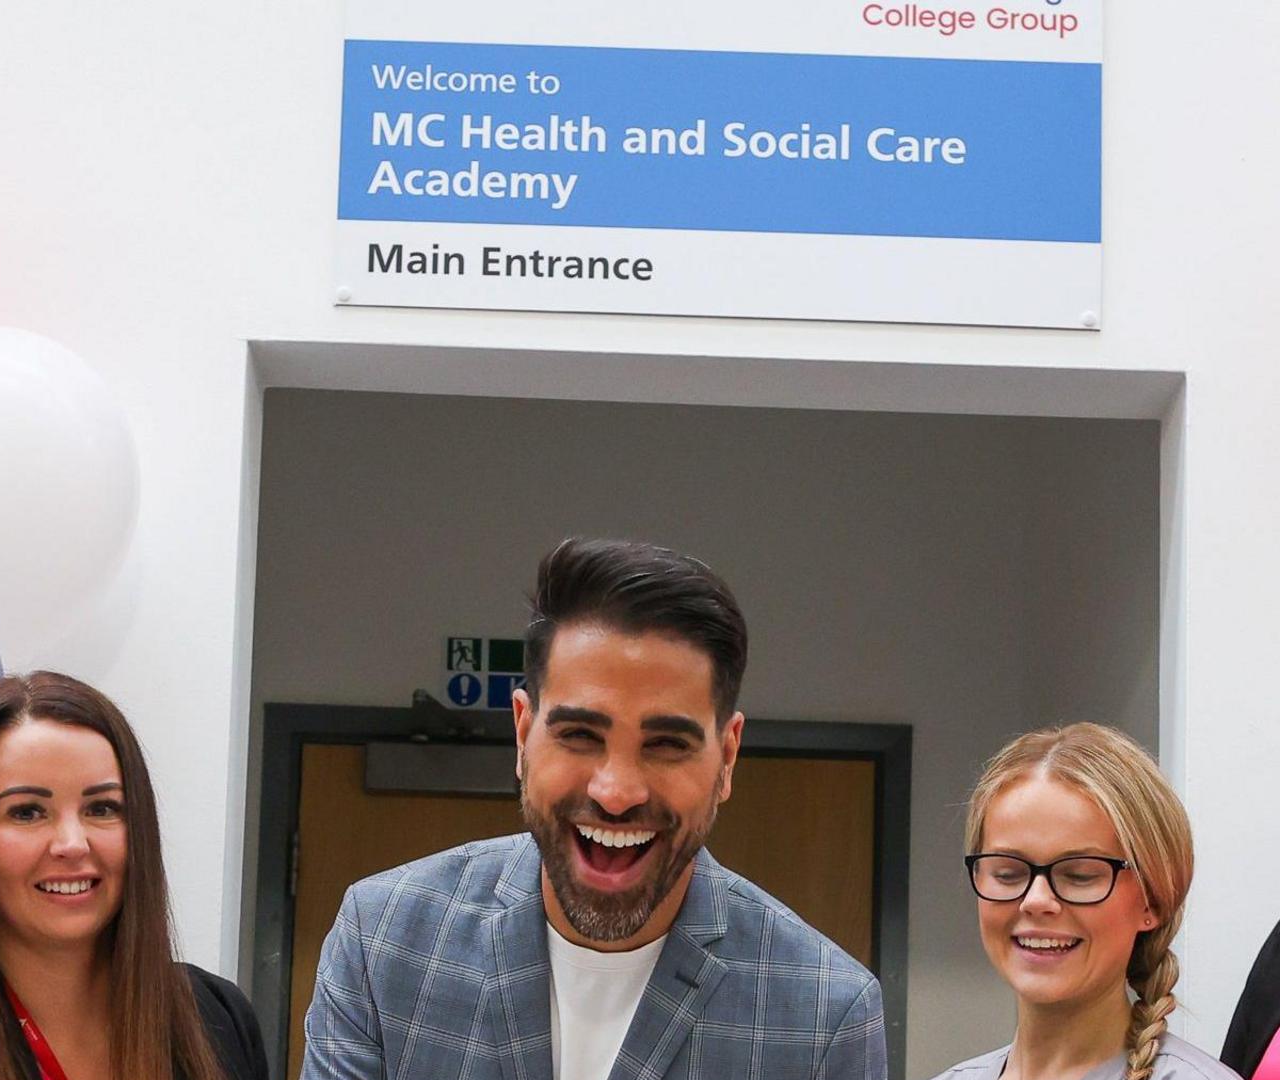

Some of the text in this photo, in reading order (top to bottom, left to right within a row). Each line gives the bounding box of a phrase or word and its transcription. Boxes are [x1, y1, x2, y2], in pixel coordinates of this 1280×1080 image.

[862, 4, 1080, 38] College Group
[371, 64, 560, 95] Welcome to
[372, 112, 967, 165] MC Health and Social Care
[367, 160, 578, 209] Academy
[367, 243, 654, 282] Main Entrance
